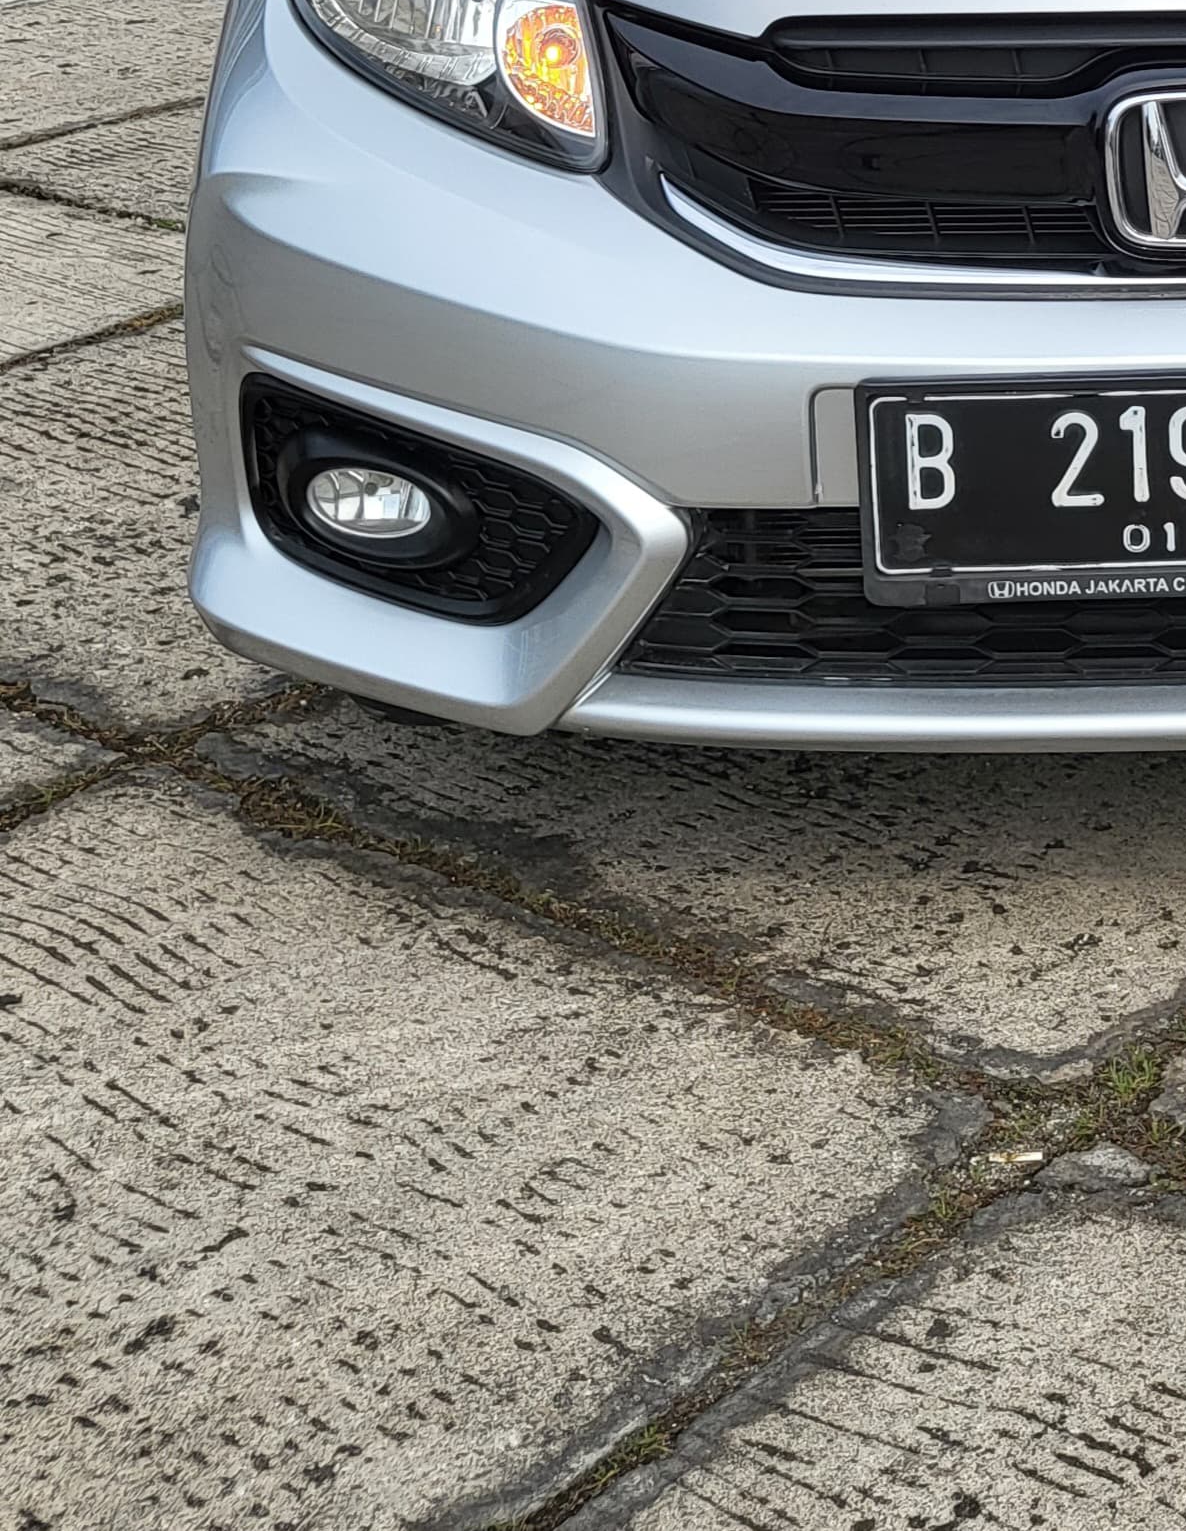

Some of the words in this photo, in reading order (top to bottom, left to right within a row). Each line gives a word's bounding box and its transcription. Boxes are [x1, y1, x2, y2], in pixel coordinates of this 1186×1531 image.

[905, 414, 956, 511] B
[1015, 581, 1082, 597] HONDA
[1085, 578, 1170, 595] JAKARTA
